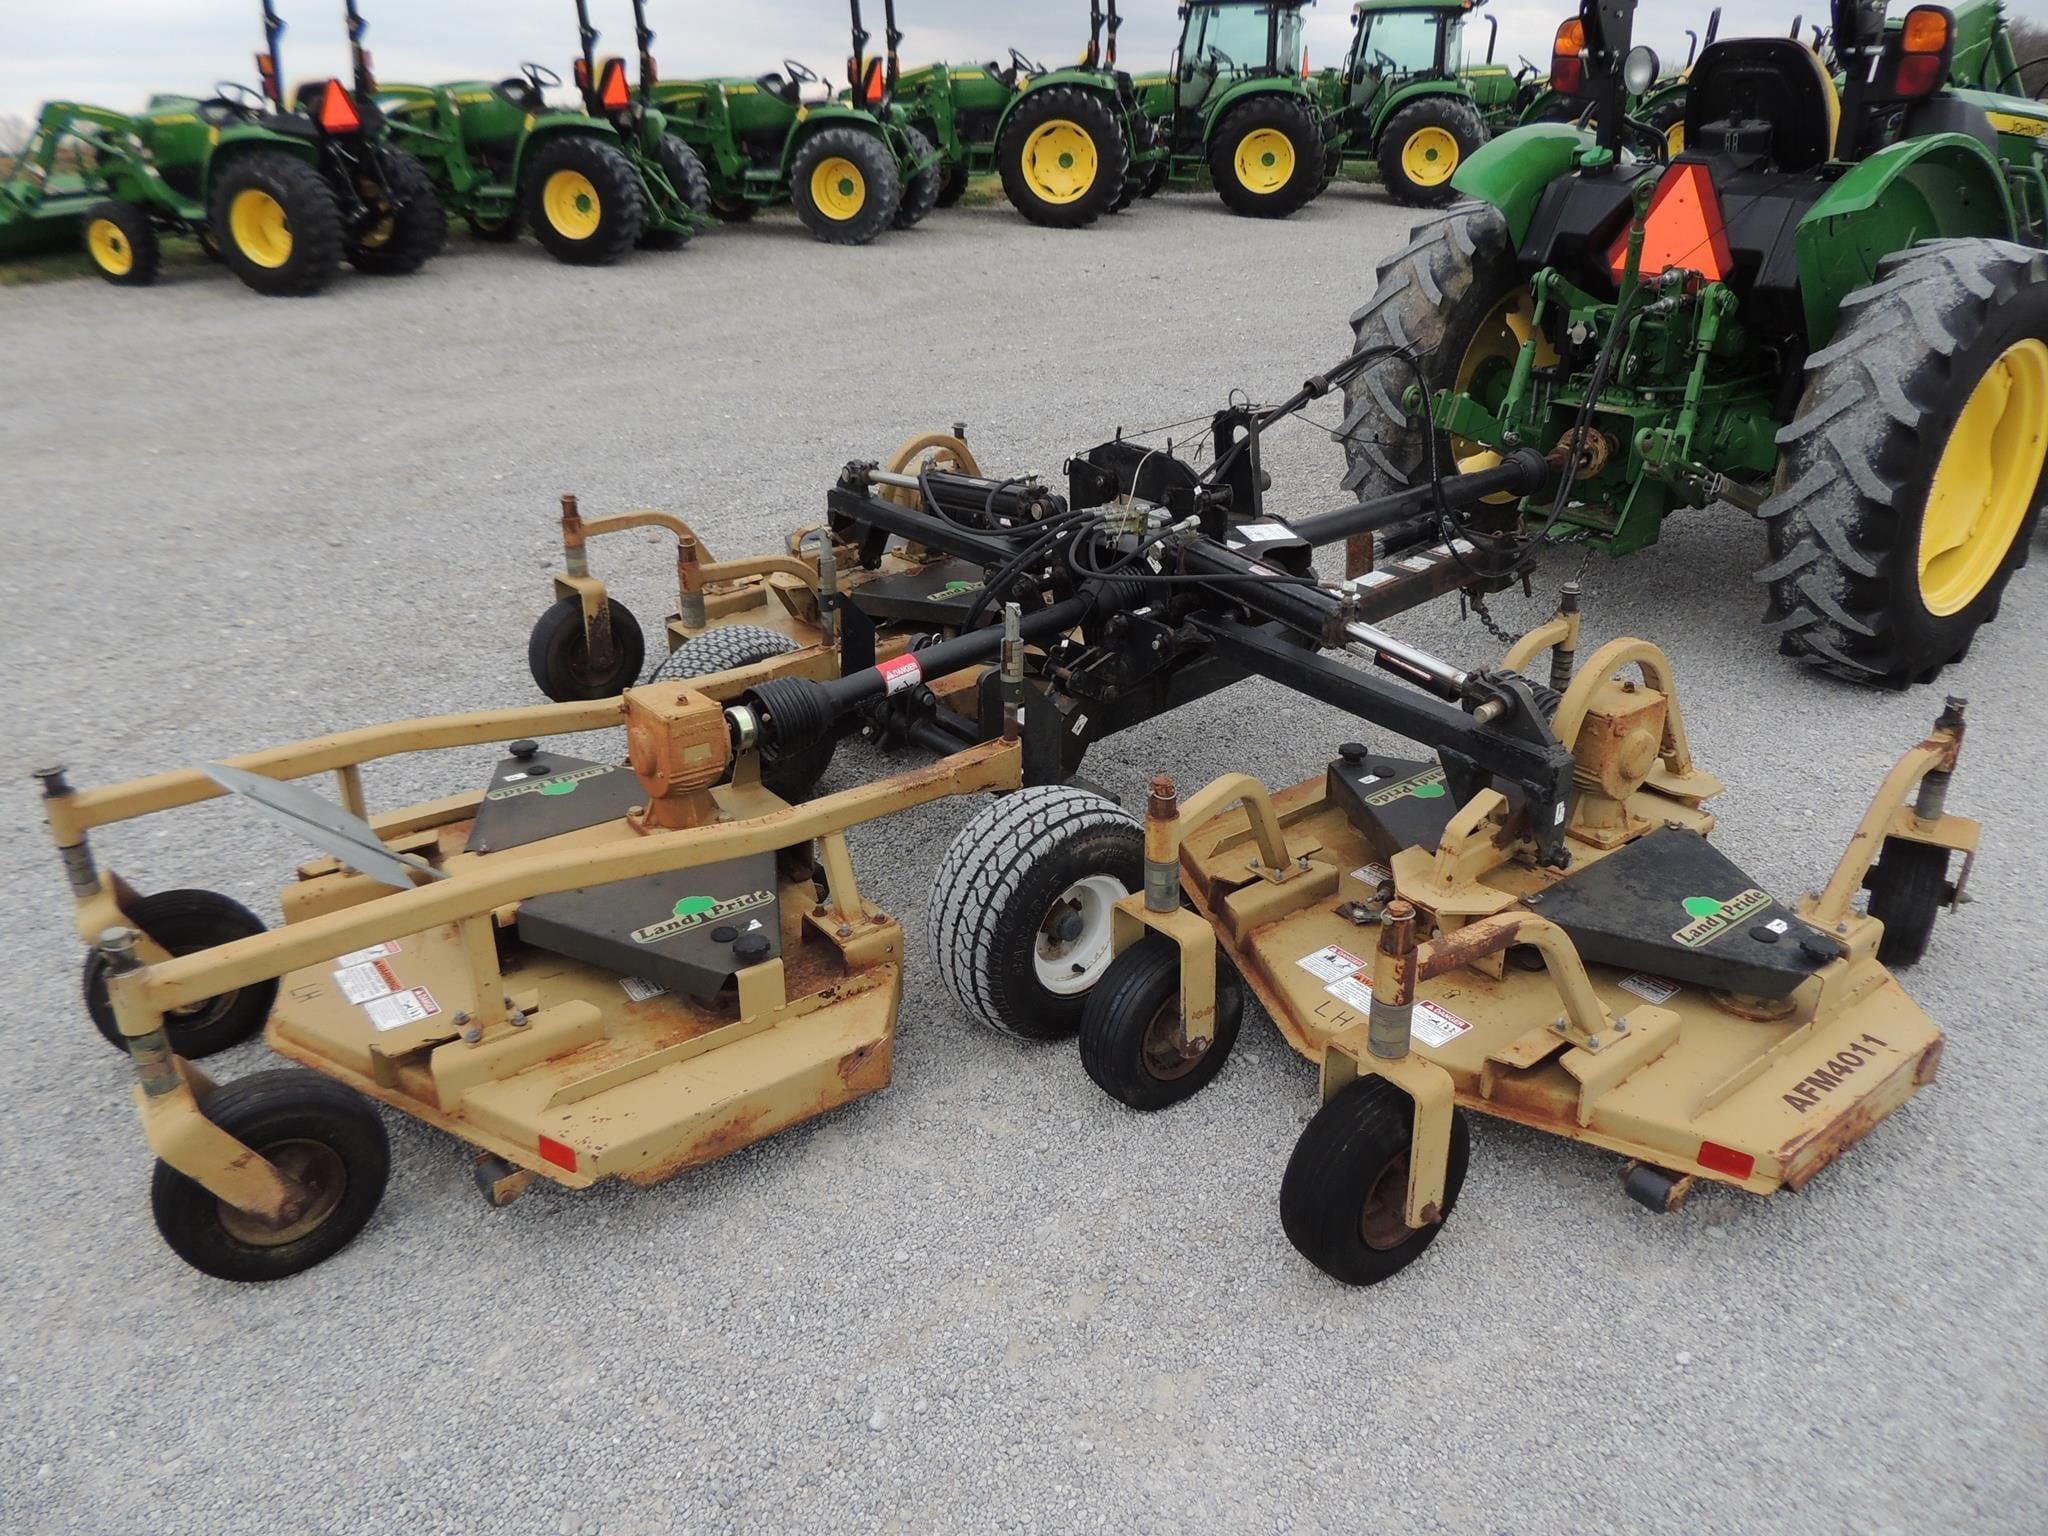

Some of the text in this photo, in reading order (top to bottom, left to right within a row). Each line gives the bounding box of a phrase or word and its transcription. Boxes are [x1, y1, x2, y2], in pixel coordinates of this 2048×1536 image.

[893, 662, 918, 676] DANGER
[1370, 769, 1445, 804] and Pride
[637, 890, 770, 940] Land Pride
[1676, 890, 1765, 943] Land Pride
[1336, 950, 1363, 966] DANGER
[1314, 1000, 1355, 1027] LH
[1434, 1008, 1467, 1028] DANGER
[1781, 1033, 1888, 1114] AFM4011
